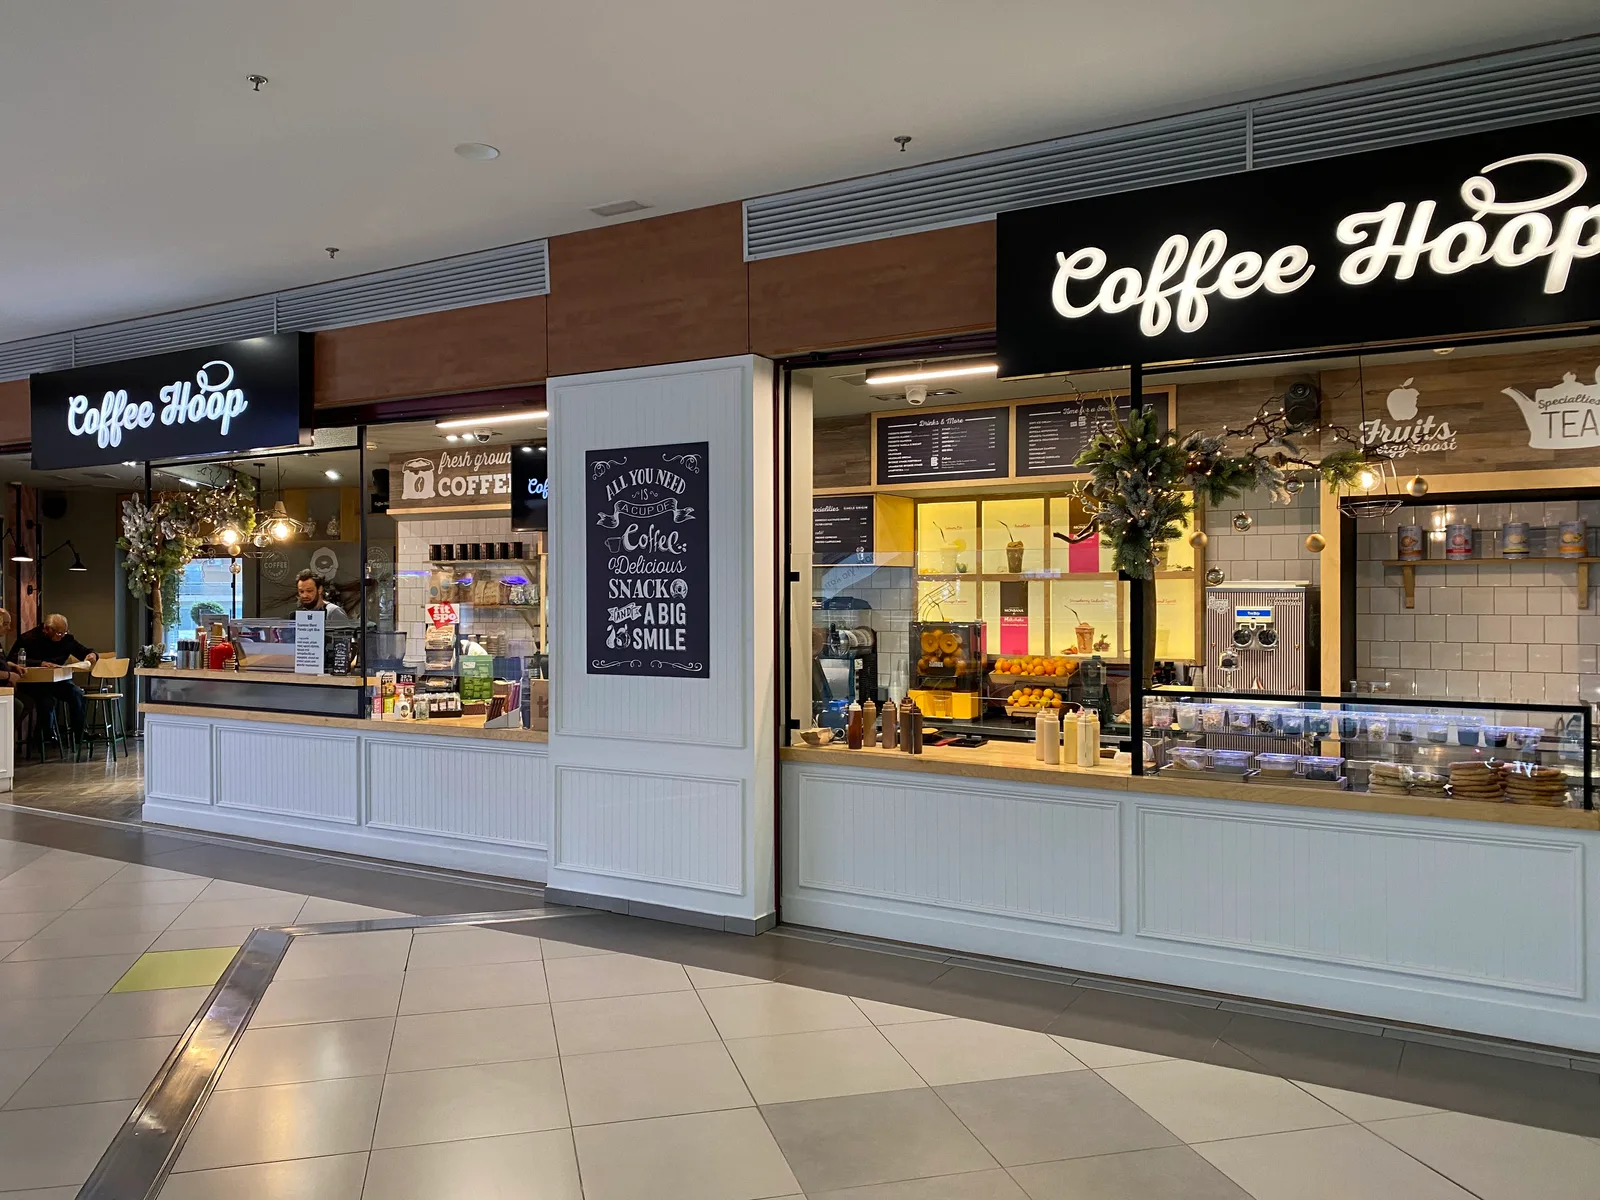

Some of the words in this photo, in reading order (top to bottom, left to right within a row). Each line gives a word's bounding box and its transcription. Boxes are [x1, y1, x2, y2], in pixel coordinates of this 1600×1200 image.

[1051, 228, 1315, 337] Coffee
[1336, 152, 1600, 294] Hoop
[68, 389, 155, 449] Coffee
[159, 360, 248, 435] Hoop
[919, 418, 939, 427] Drinks
[946, 417, 964, 425] More
[1359, 415, 1457, 445] Fruits
[1541, 409, 1599, 439] TEA
[438, 451, 472, 474] fresh
[474, 451, 511, 472] groun
[438, 473, 511, 497] COFFE
[606, 475, 628, 501] ALL
[629, 468, 653, 486] YOU
[655, 468, 686, 495] NEED
[641, 488, 649, 500] IS
[621, 504, 629, 512] A
[631, 506, 654, 515] CUP
[656, 501, 670, 512] OF
[622, 523, 681, 555] Coffee
[615, 555, 687, 574] Delicious
[608, 578, 670, 599] SNACK
[433, 613, 457, 622] spo
[434, 605, 451, 614] fit
[616, 607, 632, 620] AND
[643, 602, 655, 625] A
[658, 602, 686, 625] BIG
[632, 628, 686, 650] SMILE
